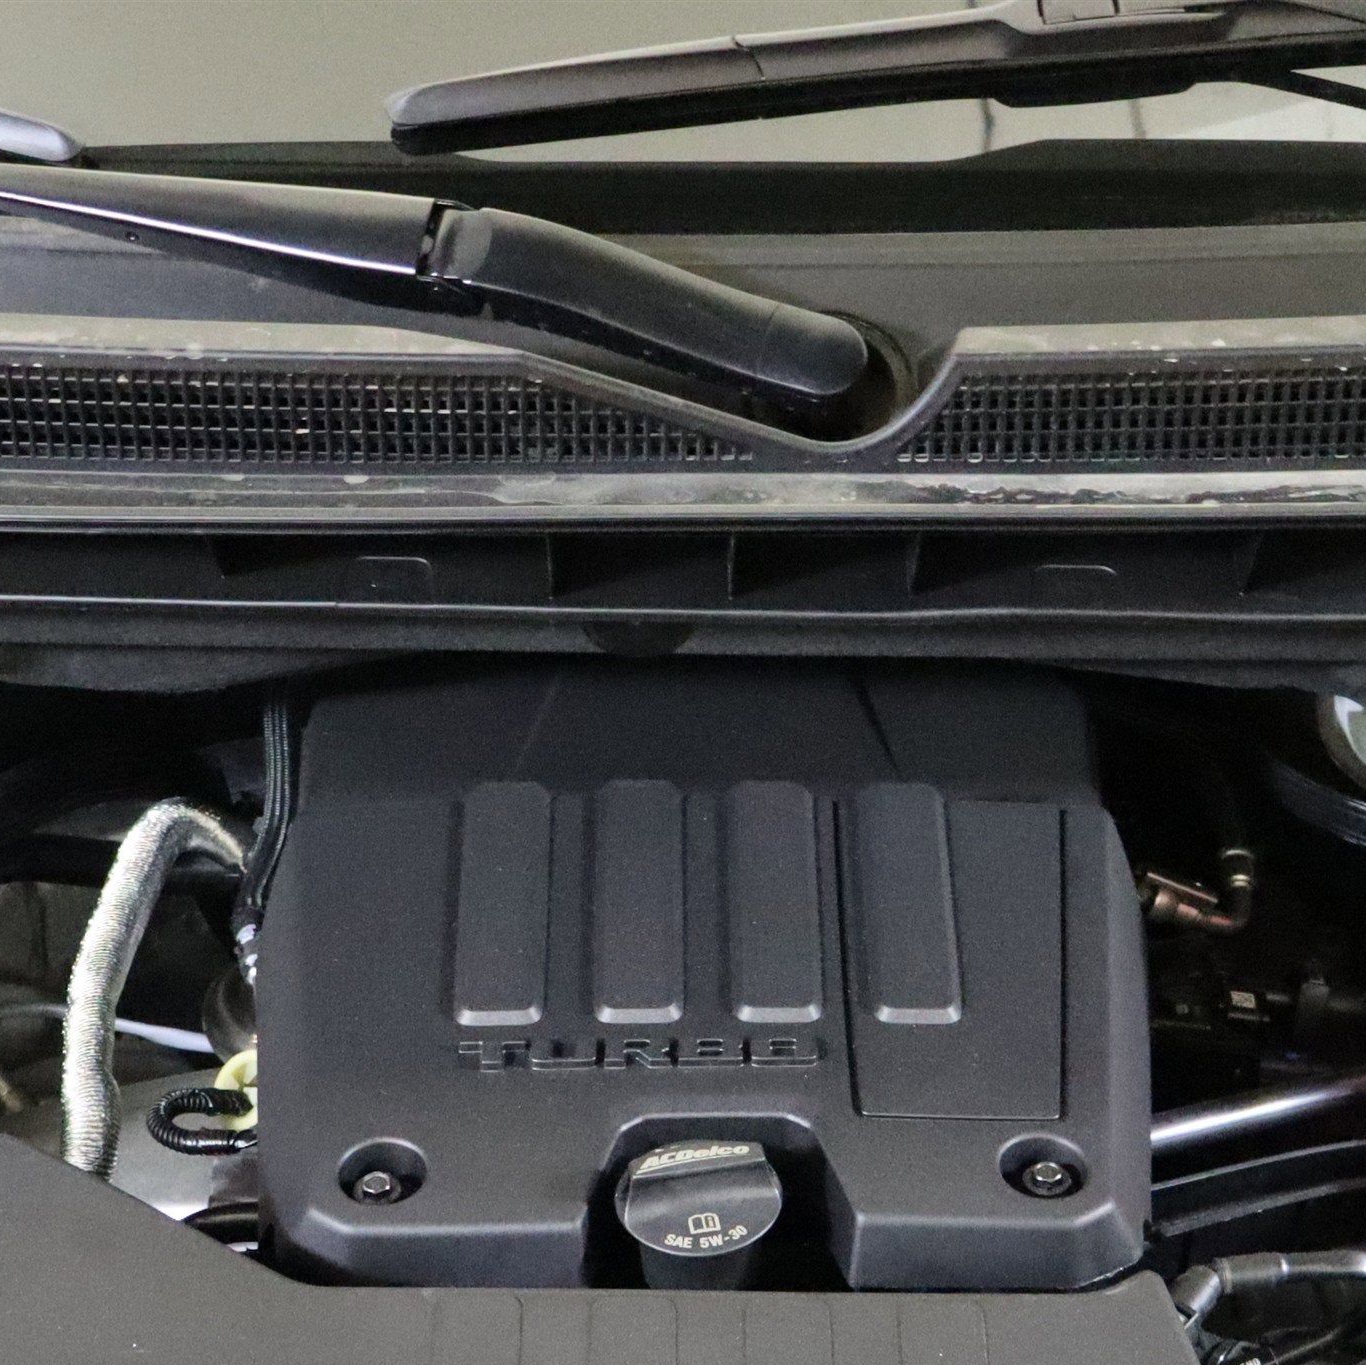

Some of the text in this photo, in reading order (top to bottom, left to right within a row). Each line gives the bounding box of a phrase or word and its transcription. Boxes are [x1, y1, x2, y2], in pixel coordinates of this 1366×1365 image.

[458, 1037, 821, 1073] TURBO
[638, 1144, 750, 1171] ACDelco
[664, 1224, 749, 1249] SAE 5W-30
